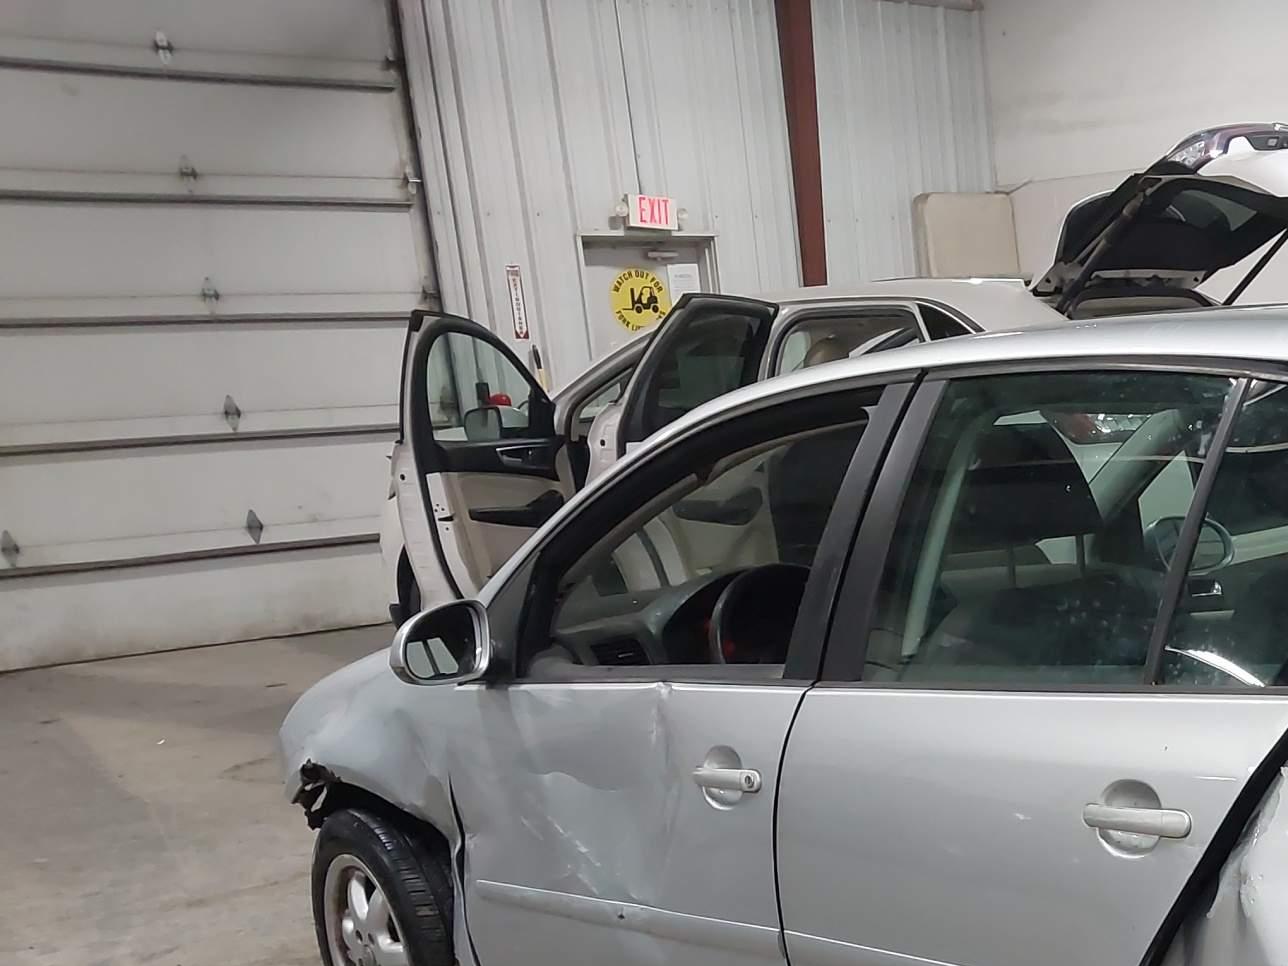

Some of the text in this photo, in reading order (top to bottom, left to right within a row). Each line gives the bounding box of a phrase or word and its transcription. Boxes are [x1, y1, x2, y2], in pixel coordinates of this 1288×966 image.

[638, 196, 669, 225] EXIT
[613, 270, 633, 293] WATCH
[634, 269, 649, 280] OUT
